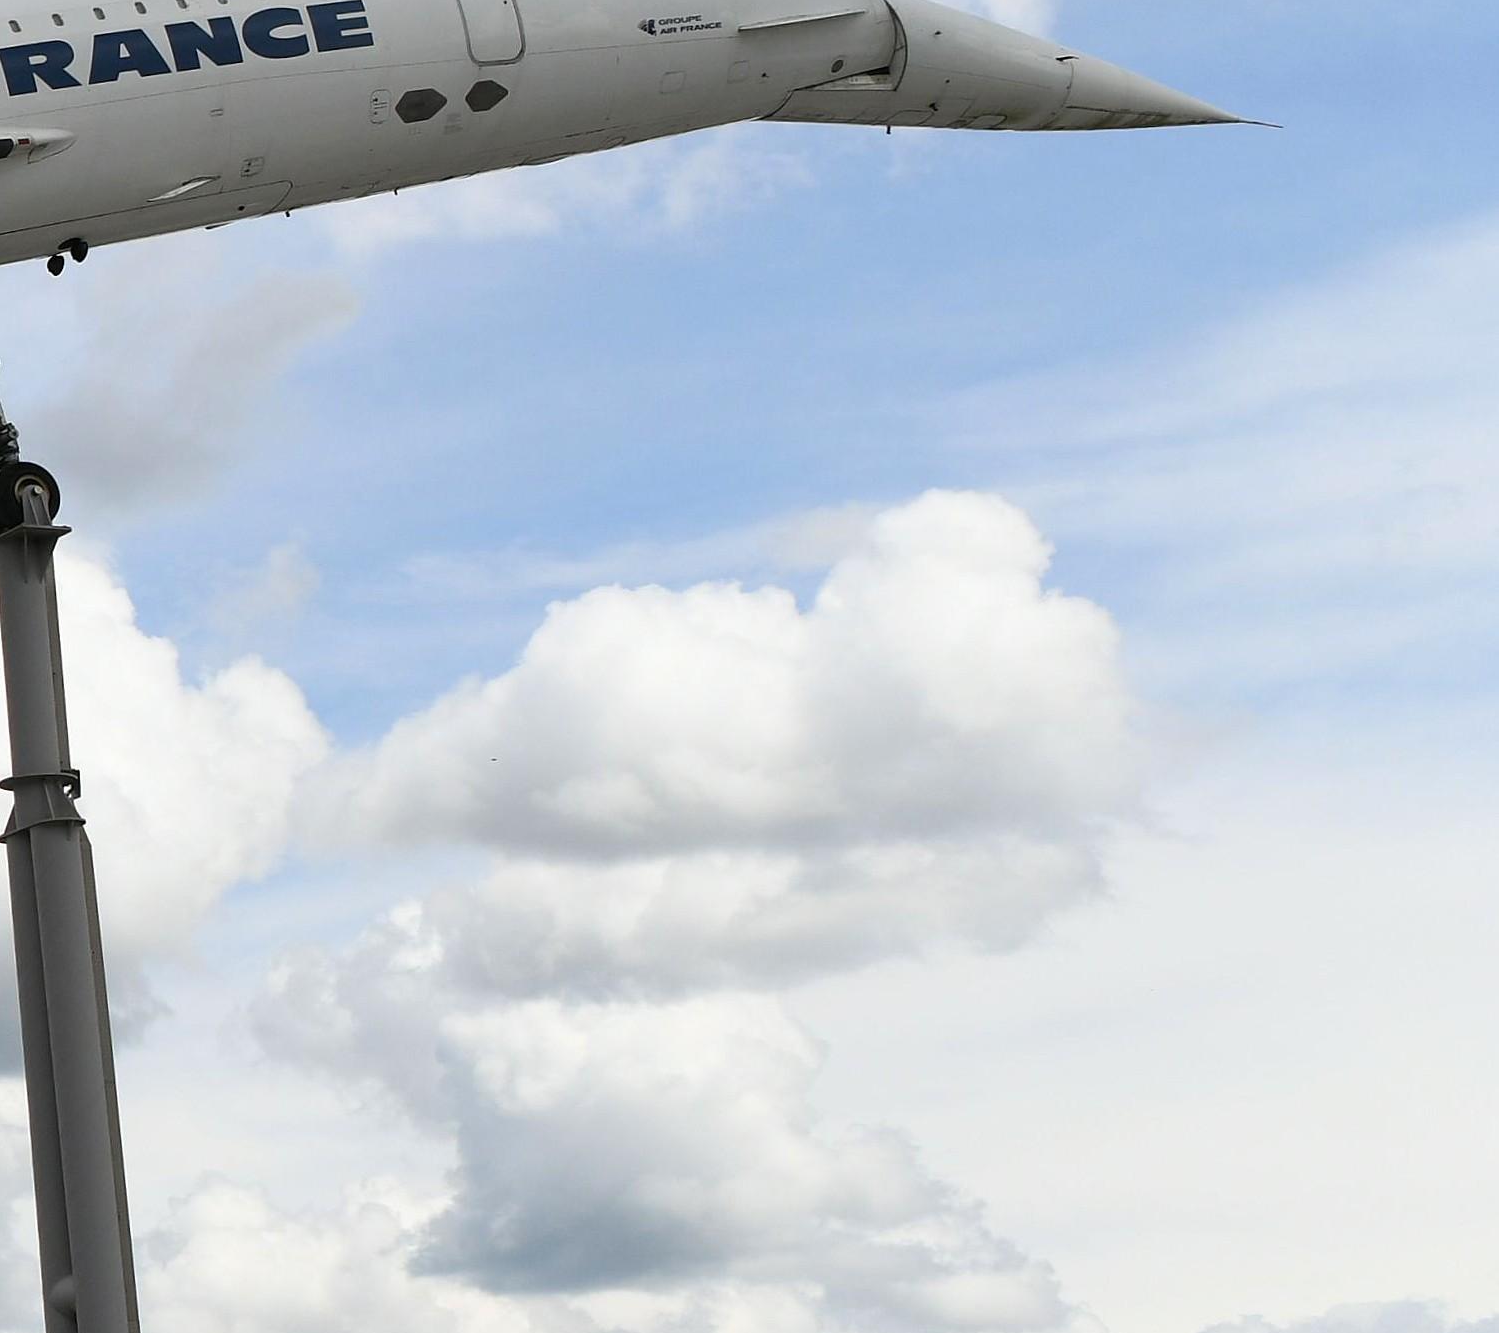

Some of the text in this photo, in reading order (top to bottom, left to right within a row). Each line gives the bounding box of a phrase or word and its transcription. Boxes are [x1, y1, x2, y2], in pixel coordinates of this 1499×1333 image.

[658, 15, 702, 26] GROUPE
[660, 22, 722, 35] AIR FRANCE
